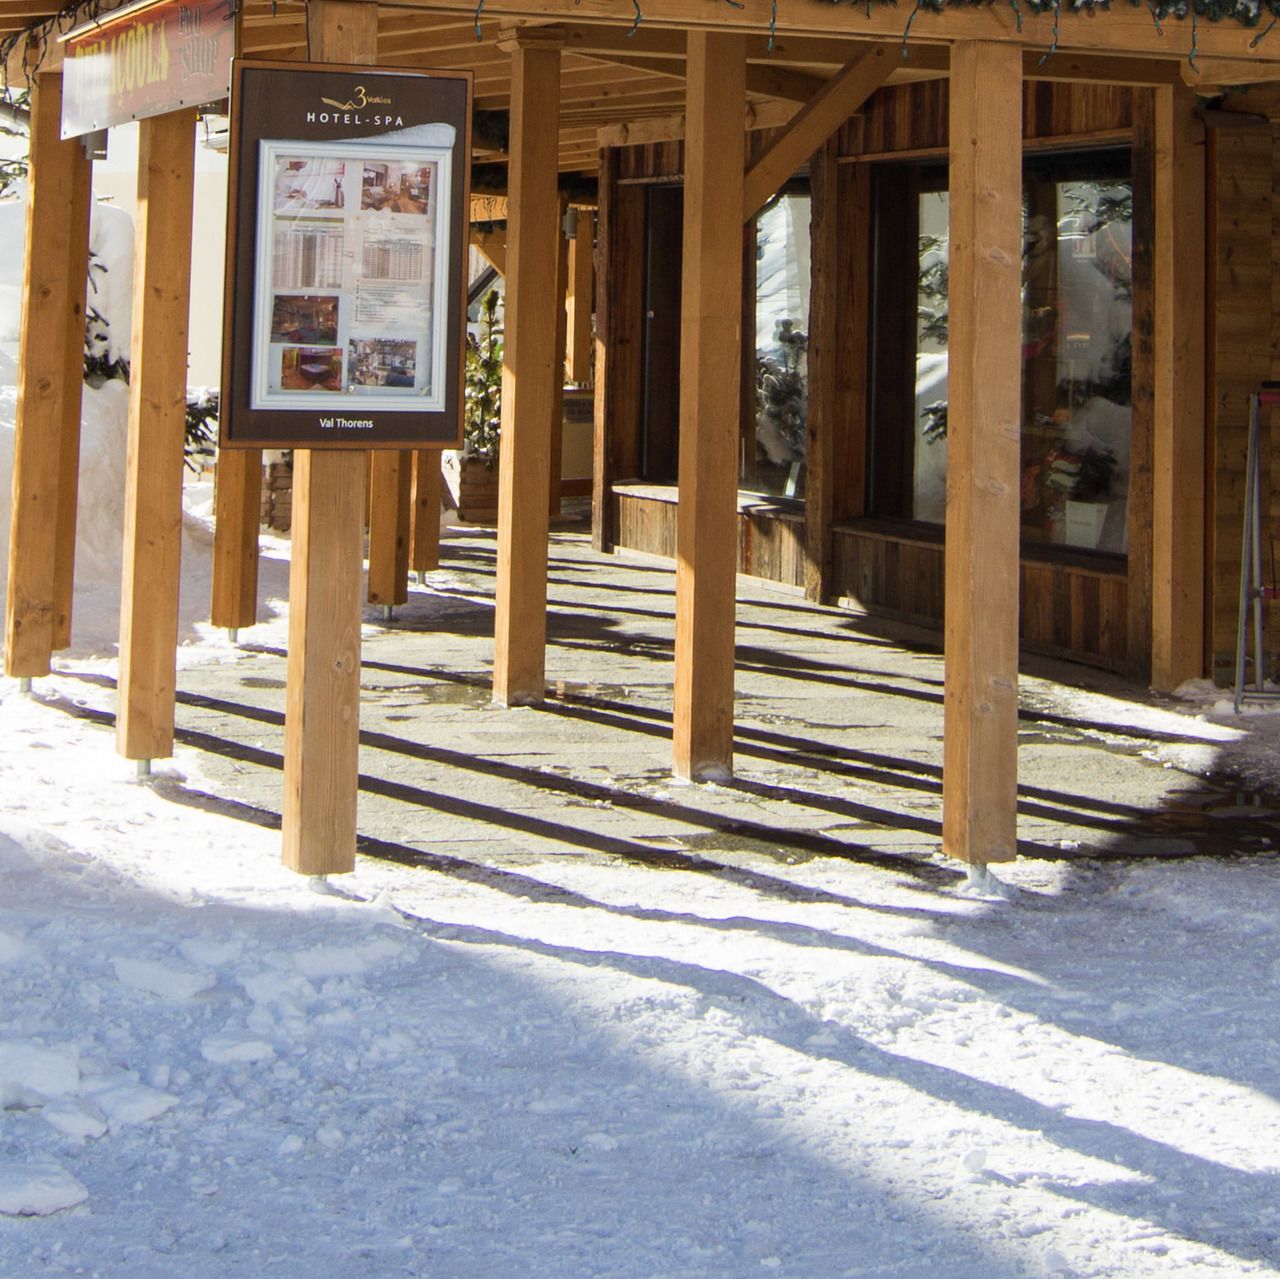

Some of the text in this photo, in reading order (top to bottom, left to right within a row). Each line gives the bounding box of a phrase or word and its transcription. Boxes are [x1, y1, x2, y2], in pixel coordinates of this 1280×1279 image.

[354, 86, 367, 109] 3
[319, 418, 374, 429] Val Thorens
